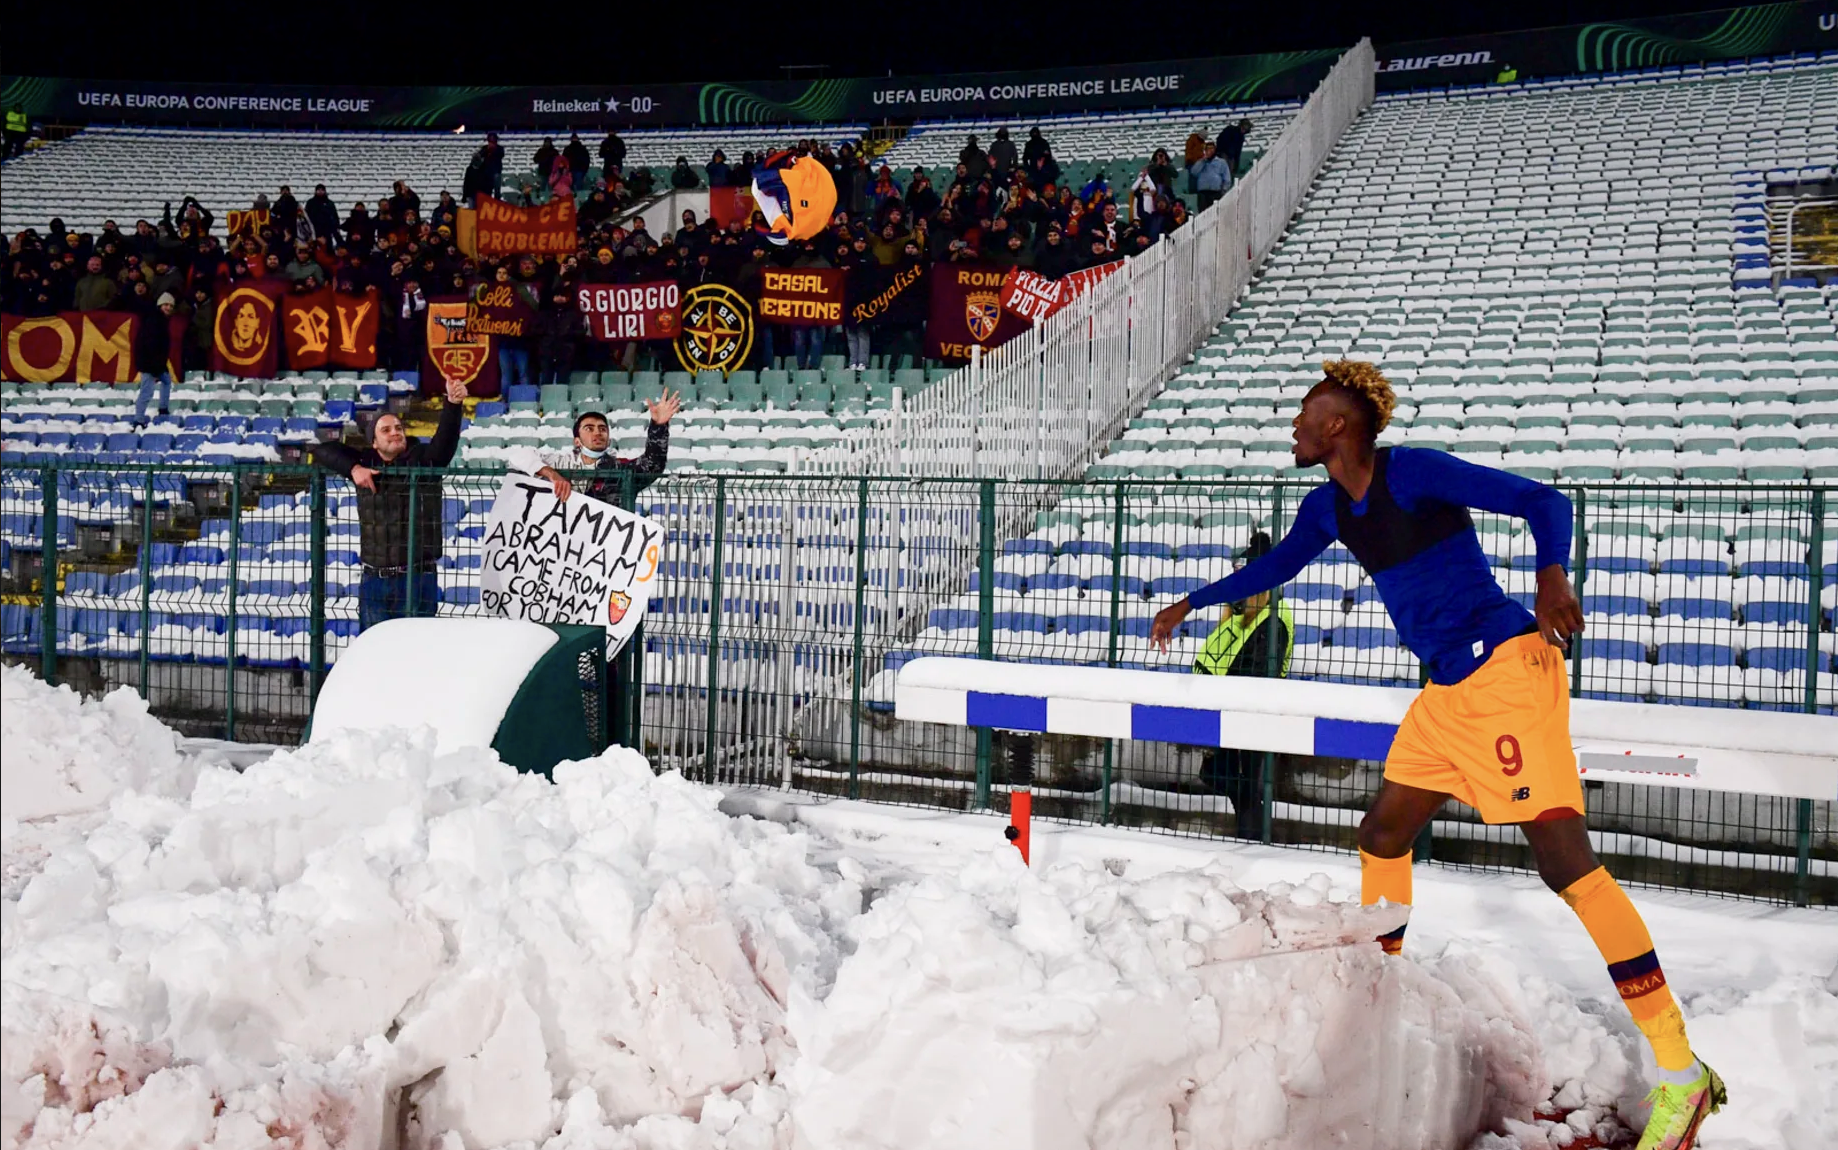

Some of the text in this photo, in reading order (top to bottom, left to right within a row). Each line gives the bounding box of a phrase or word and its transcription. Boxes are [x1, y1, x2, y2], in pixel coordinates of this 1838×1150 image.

[78, 92, 370, 112] UEFA EUROPA CONFERENCE LEAGUE
[533, 98, 600, 113] Heineken
[873, 75, 1179, 105] UEFA EUROPA CONFERENCE LEAGUE
[479, 230, 576, 250] PROBLEMA
[764, 272, 828, 294] CASAL
[852, 262, 923, 324] Royalist
[1015, 270, 1062, 304] PIAZZA
[1006, 288, 1034, 316] PIO
[604, 313, 645, 338] LIRI
[515, 483, 657, 561] TAMMY
[485, 521, 637, 587] ABRAHAM
[636, 545, 658, 582] 9
[493, 549, 556, 585] CAME
[558, 566, 607, 603] FROM
[508, 576, 598, 623] COBHAM
[1495, 734, 1523, 776] 9
